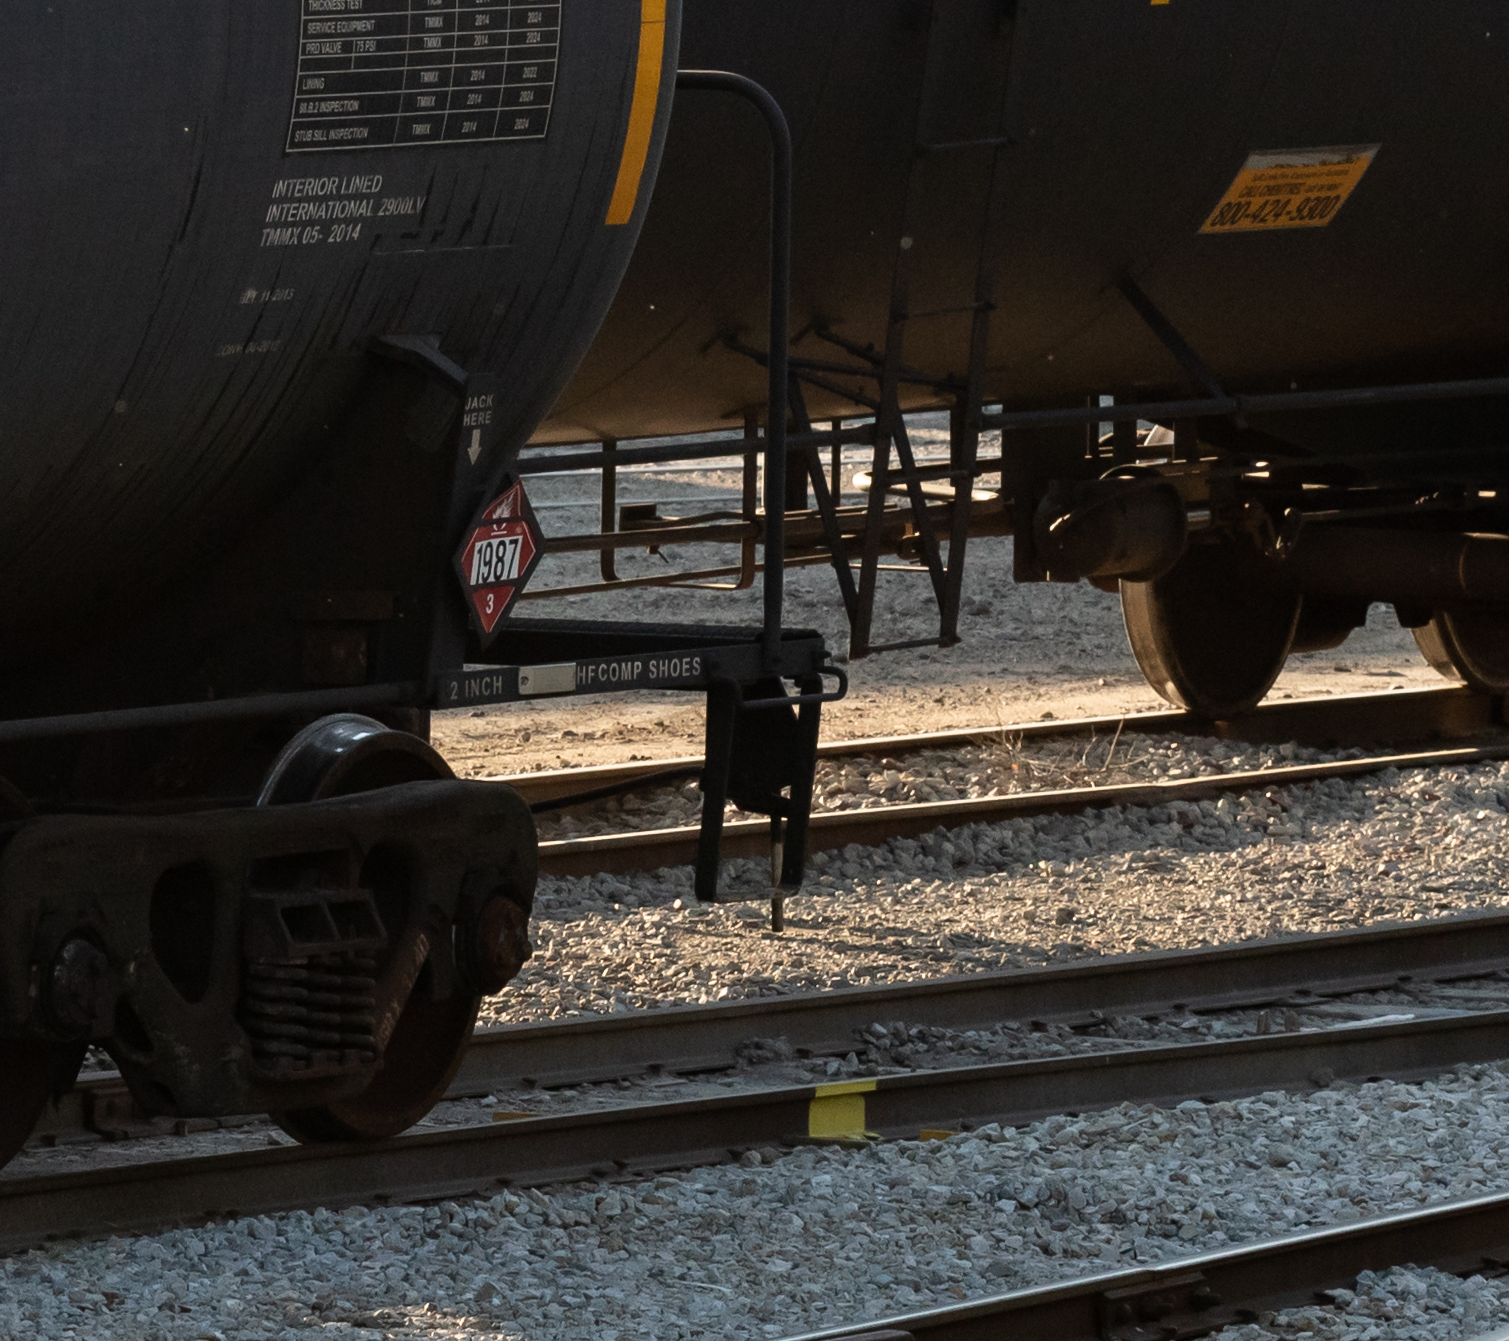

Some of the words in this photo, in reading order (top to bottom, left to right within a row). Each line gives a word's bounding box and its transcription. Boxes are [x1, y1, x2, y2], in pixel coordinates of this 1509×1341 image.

[309, 0, 345, 11] THICKNESS
[475, 14, 489, 25] 2014
[528, 12, 542, 23] 2024
[308, 22, 335, 34] SERVICE
[337, 20, 375, 32] EQUIPMENT
[474, 34, 489, 45] 2014
[527, 32, 541, 43] 2024
[321, 42, 342, 53] VALVE
[471, 70, 485, 80] 2014
[523, 67, 538, 78] 2022
[467, 94, 482, 105] 2014
[519, 91, 534, 102] 2024
[319, 100, 359, 112] INSPECTION
[462, 122, 477, 133] 2014
[514, 119, 530, 130] 2024
[295, 130, 313, 142] STUB
[329, 128, 369, 140] INSPECTION
[272, 177, 339, 198] INTERIOR
[341, 175, 382, 194] LINED
[266, 199, 374, 222] INTERNATIONAL
[1210, 194, 1341, 227] 800-424-9300
[261, 228, 301, 247] TMMX
[465, 395, 493, 410] JACK
[463, 411, 492, 427] HERE
[476, 539, 519, 584] 1987
[486, 593, 494, 614] 3
[450, 681, 458, 700] 2
[465, 676, 503, 698] INCH
[649, 658, 701, 678] SHOES
